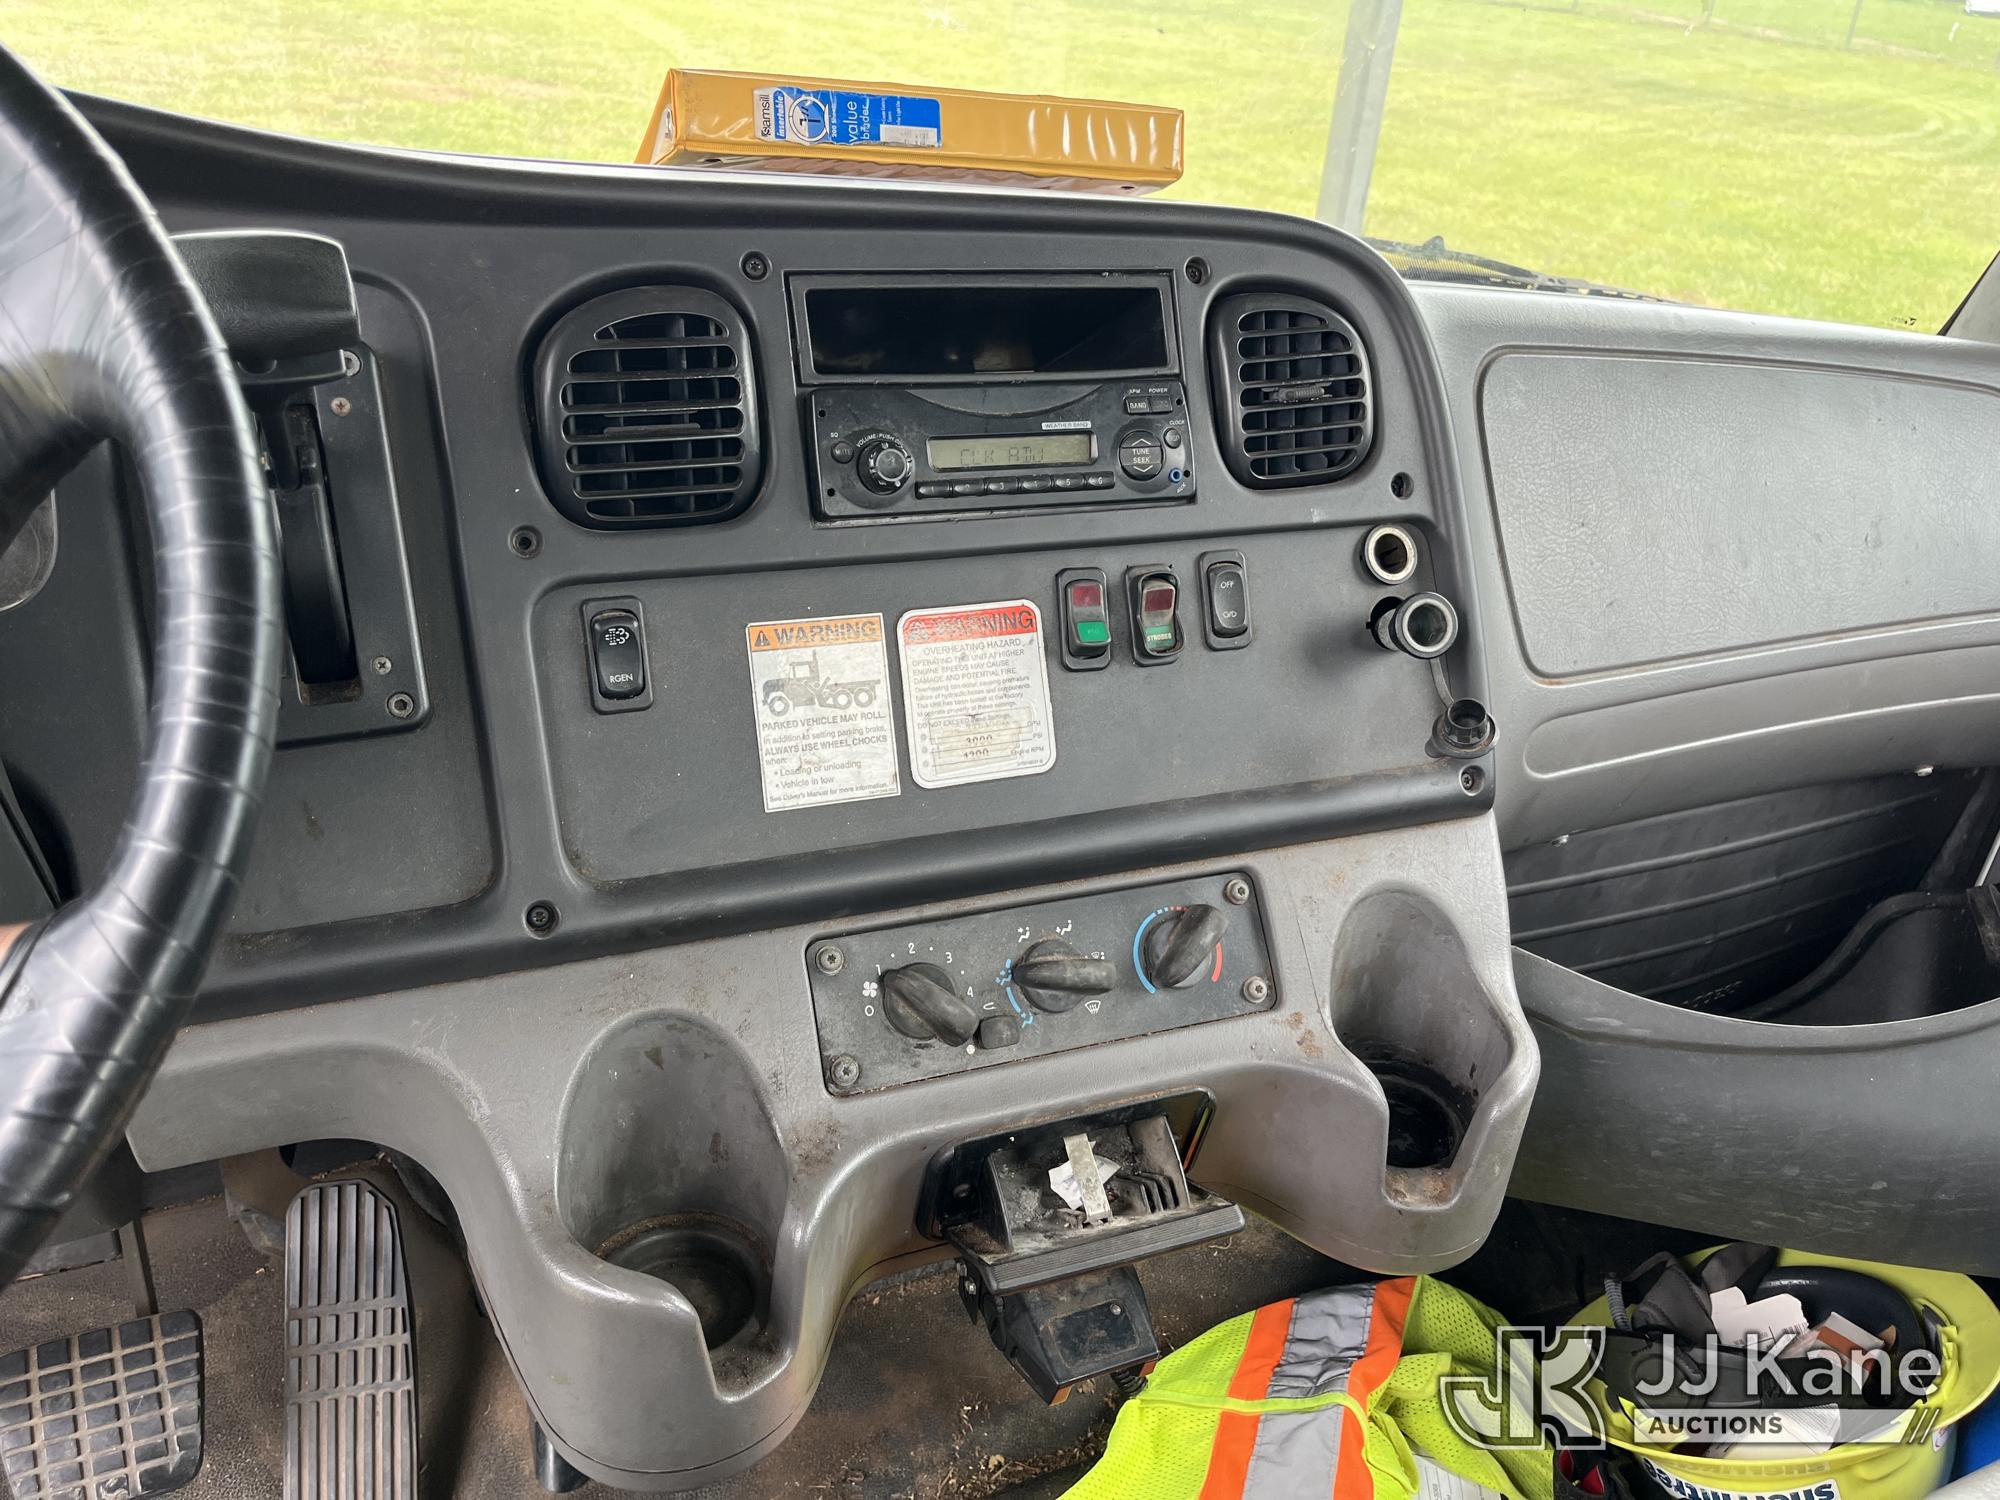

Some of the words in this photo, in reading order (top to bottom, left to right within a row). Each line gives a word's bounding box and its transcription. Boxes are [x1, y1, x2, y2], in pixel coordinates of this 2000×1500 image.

[842, 101, 858, 142] value
[856, 433, 877, 448] VOLUME
[1132, 456, 1151, 464] SEEK
[999, 482, 1005, 490] 3
[1065, 478, 1071, 486] 5
[1097, 477, 1103, 485] 6
[1176, 482, 1187, 494] AUX
[1220, 580, 1235, 589] OFF
[773, 620, 877, 645] WARNING
[923, 640, 985, 656] OVERHEATING
[986, 637, 1022, 649] HAZARD
[912, 656, 953, 667] OPERATING
[999, 649, 1025, 659] HIGHER
[986, 659, 1010, 669] CAUSE
[609, 673, 634, 684] RGEN
[913, 675, 944, 686] DAMAGE
[945, 673, 960, 682] AND
[961, 669, 999, 681] POTENTIAL
[762, 719, 799, 731] PARKED
[800, 715, 838, 728] VEHICLE
[839, 713, 858, 723] MAY
[772, 732, 801, 744] addition
[811, 729, 836, 741] setting
[837, 727, 864, 739] parking
[764, 745, 800, 757] ALWAYS
[801, 742, 820, 752] USE
[820, 739, 851, 749] WHEEL
[852, 734, 888, 746] CHOCKS
[779, 765, 812, 777] Loading
[813, 765, 823, 774] or
[824, 760, 862, 773] unloading
[781, 778, 810, 789] Vehicle
[811, 776, 819, 786] in
[820, 775, 835, 785] tow
[908, 942, 916, 954] 2
[945, 952, 953, 964] 3
[967, 985, 974, 998] 4
